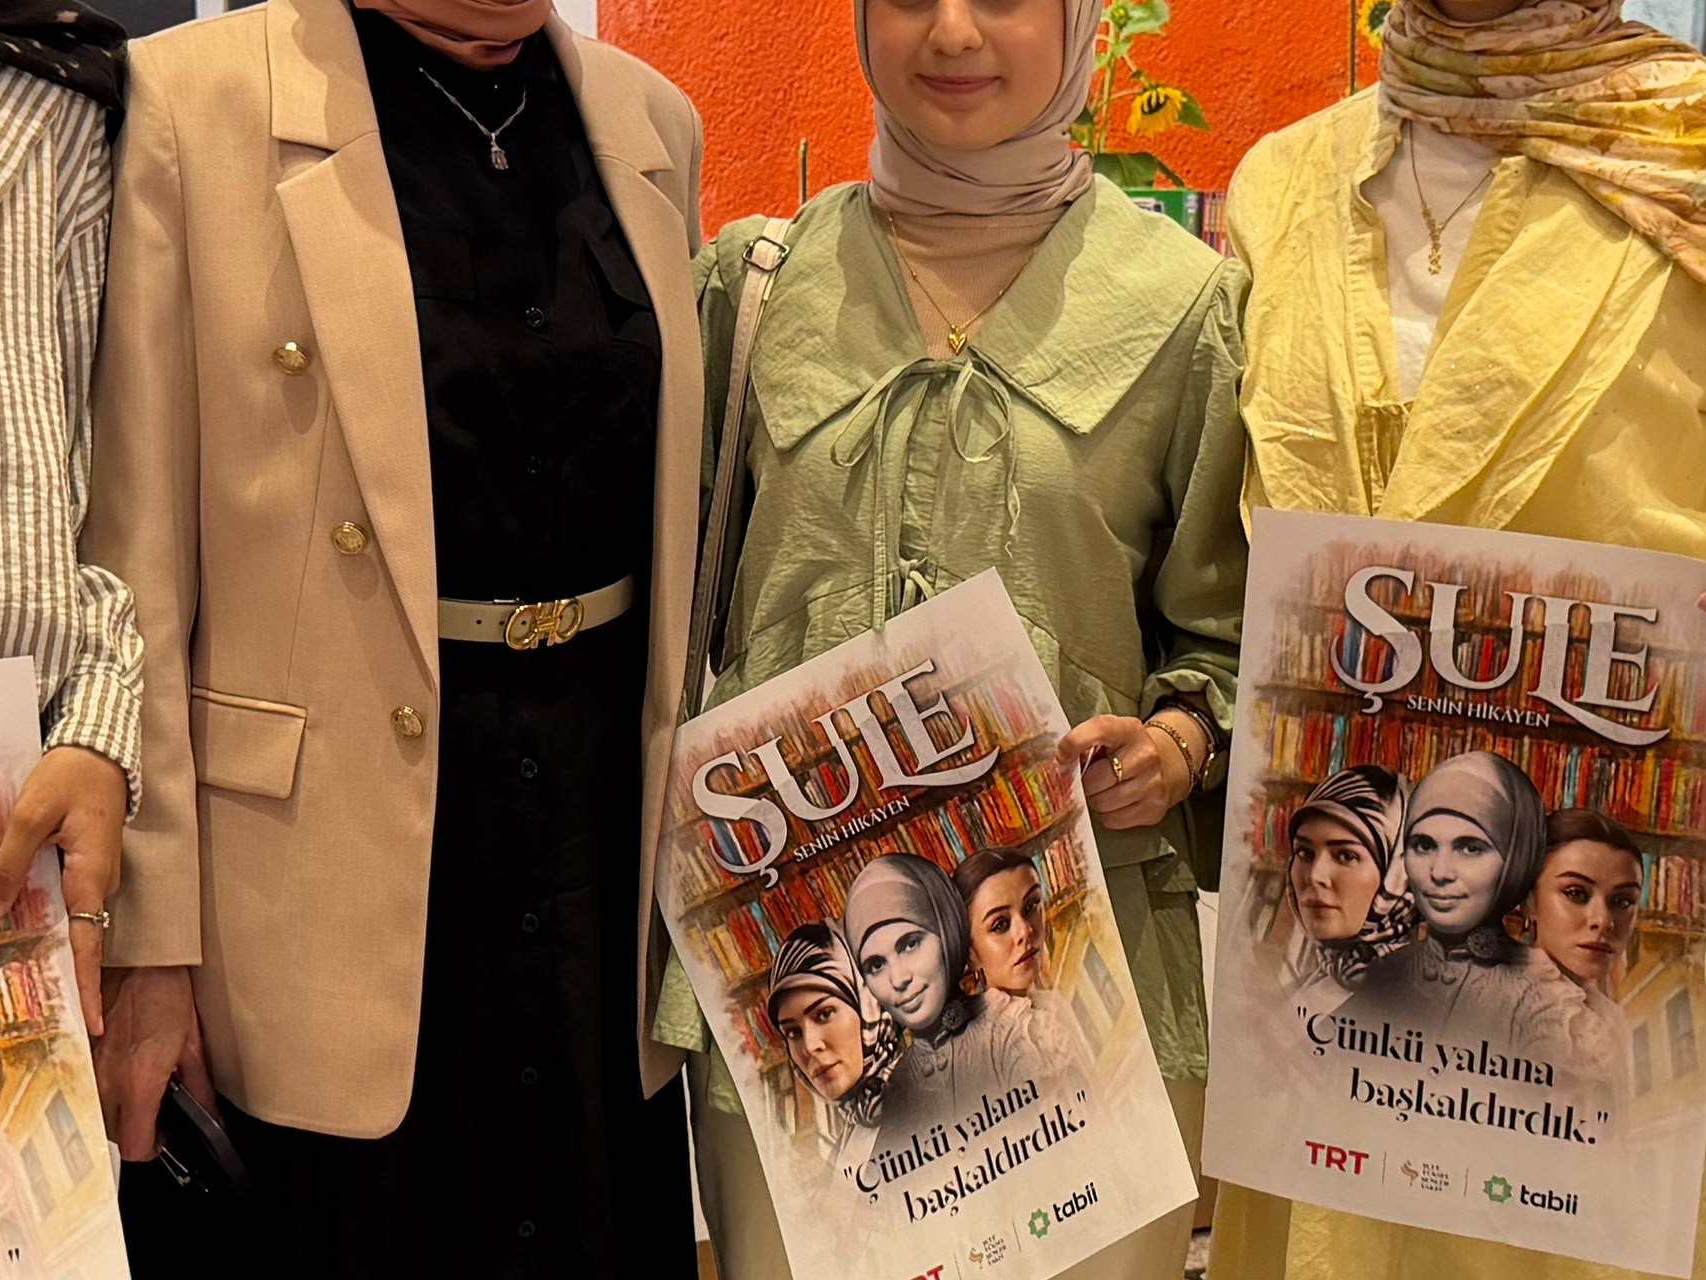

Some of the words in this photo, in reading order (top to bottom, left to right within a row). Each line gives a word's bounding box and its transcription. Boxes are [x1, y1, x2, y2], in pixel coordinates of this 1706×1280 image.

[1330, 566, 1670, 745] ŞULE
[1406, 694, 1463, 715] SENİN
[1467, 702, 1550, 728] HİKÂYEN
[693, 658, 1000, 889] ŞULE
[793, 830, 840, 863] SENİN
[843, 795, 910, 839] HİKÂYEN
[1297, 1006, 1424, 1064] "Çünkü
[1428, 1040, 1554, 1087] yalana
[844, 1124, 951, 1204] "Çünkü
[954, 1079, 1039, 1158] yalana
[1351, 1066, 1608, 1144] başkaldırdık."
[903, 1090, 1086, 1223] başkaldırdık."
[1305, 1140, 1369, 1175] TRT
[1520, 1184, 1578, 1215] tabii
[1052, 1182, 1098, 1222] tabii
